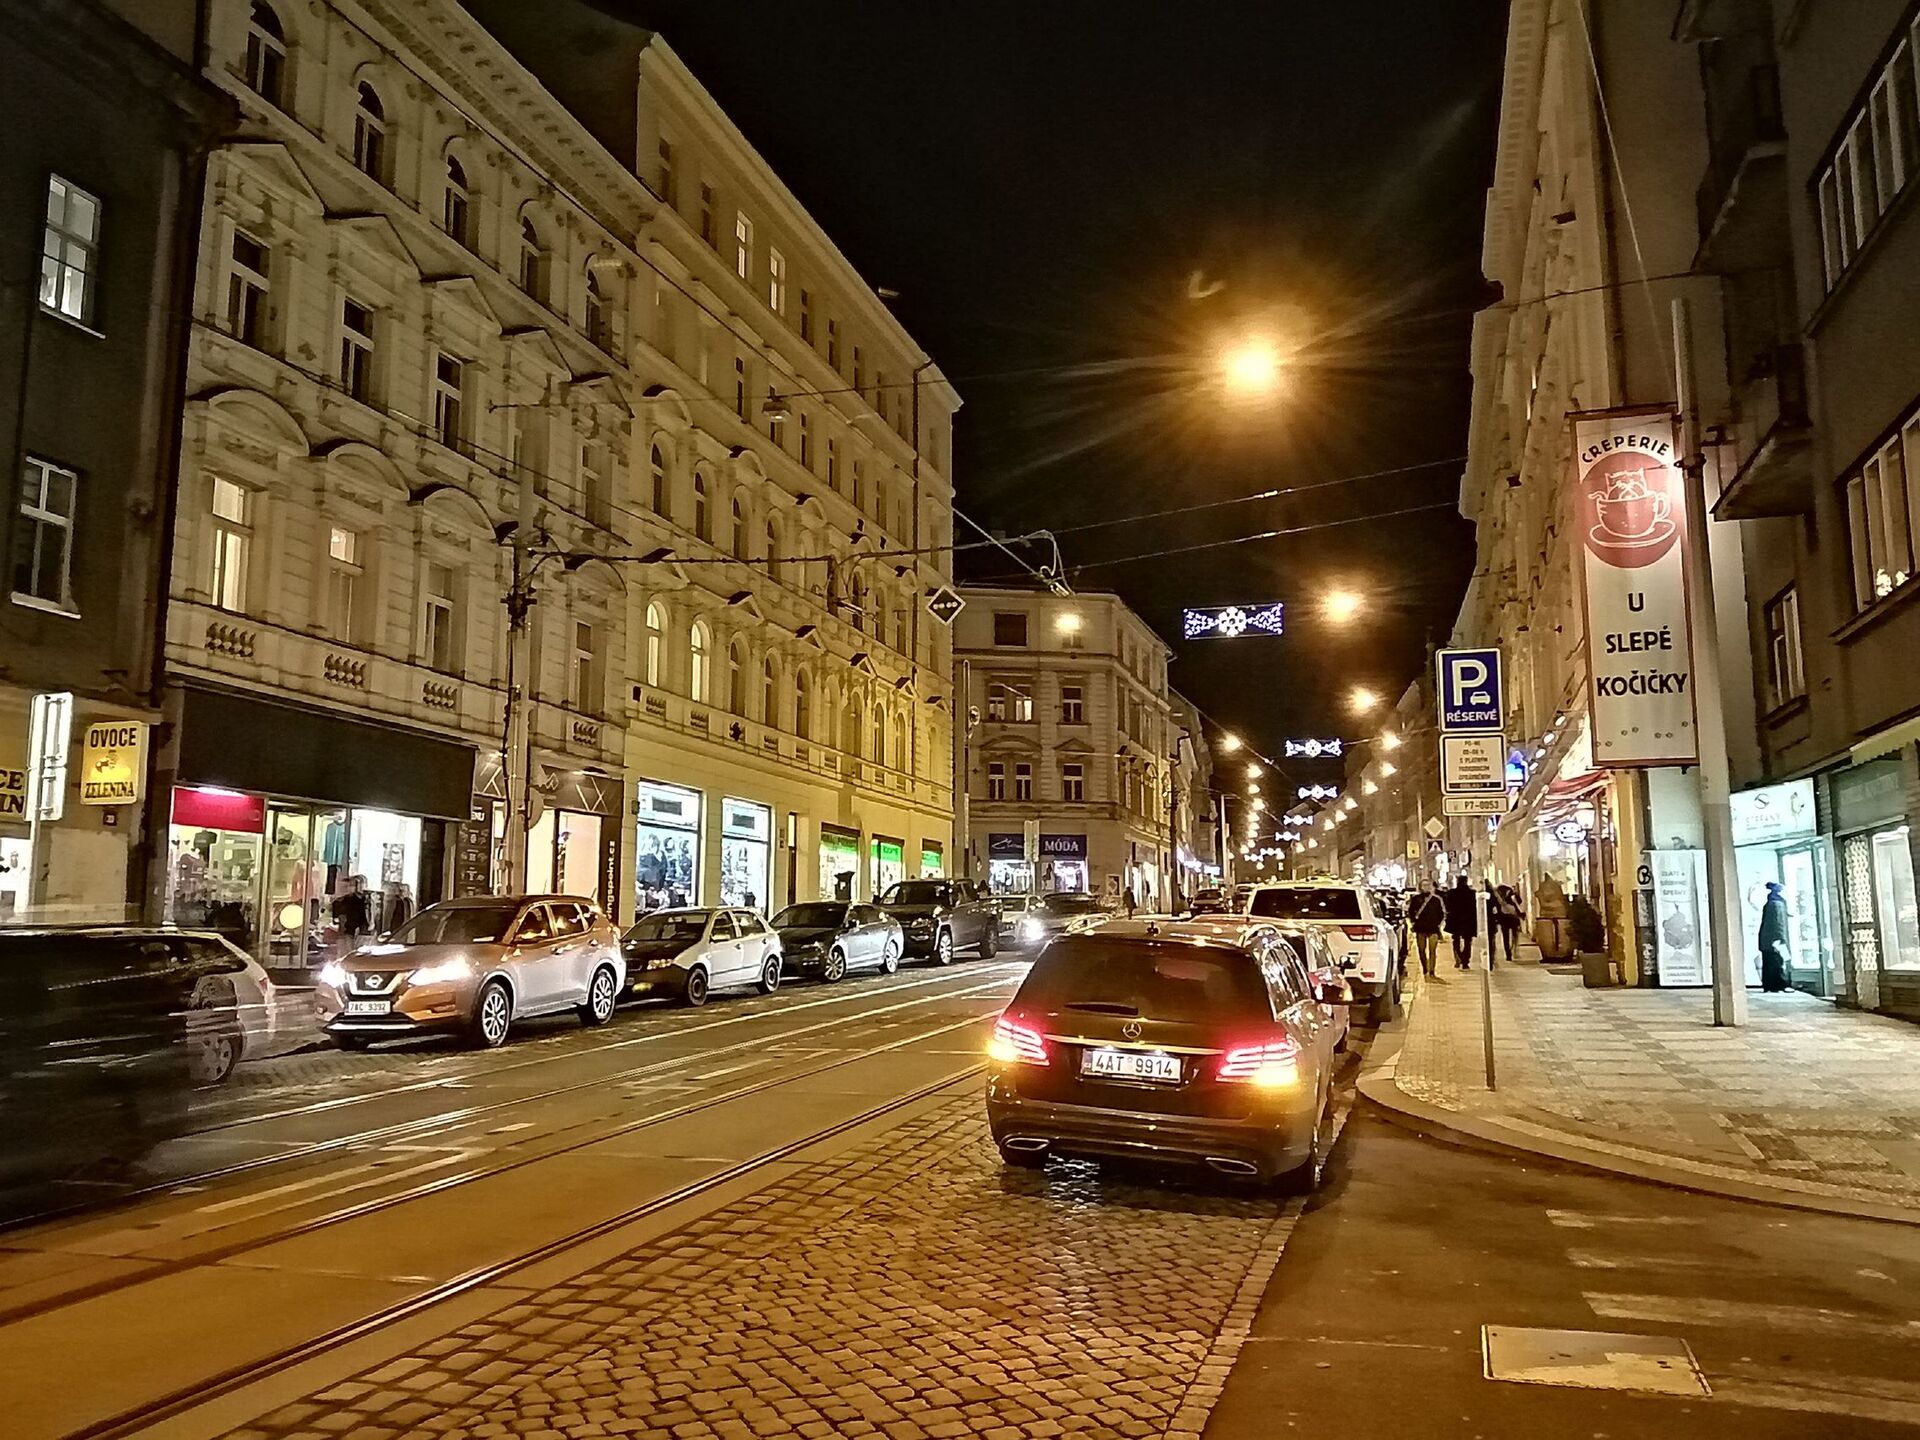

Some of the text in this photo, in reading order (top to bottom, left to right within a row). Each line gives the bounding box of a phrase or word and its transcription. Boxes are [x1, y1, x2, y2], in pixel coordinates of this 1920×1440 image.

[1582, 435, 1669, 463] CREPERIE
[1628, 593, 1644, 612] U
[1605, 625, 1672, 653] SLEPÉ
[1452, 659, 1487, 706] P
[1596, 669, 1688, 696] KOČIČKY
[1446, 709, 1498, 722] RÉSERVÉ
[90, 728, 137, 747] OVOCE
[85, 781, 135, 798] ZELENINA
[1044, 838, 1079, 852] MÓDA
[1096, 1055, 1173, 1076] 4AT 9914
